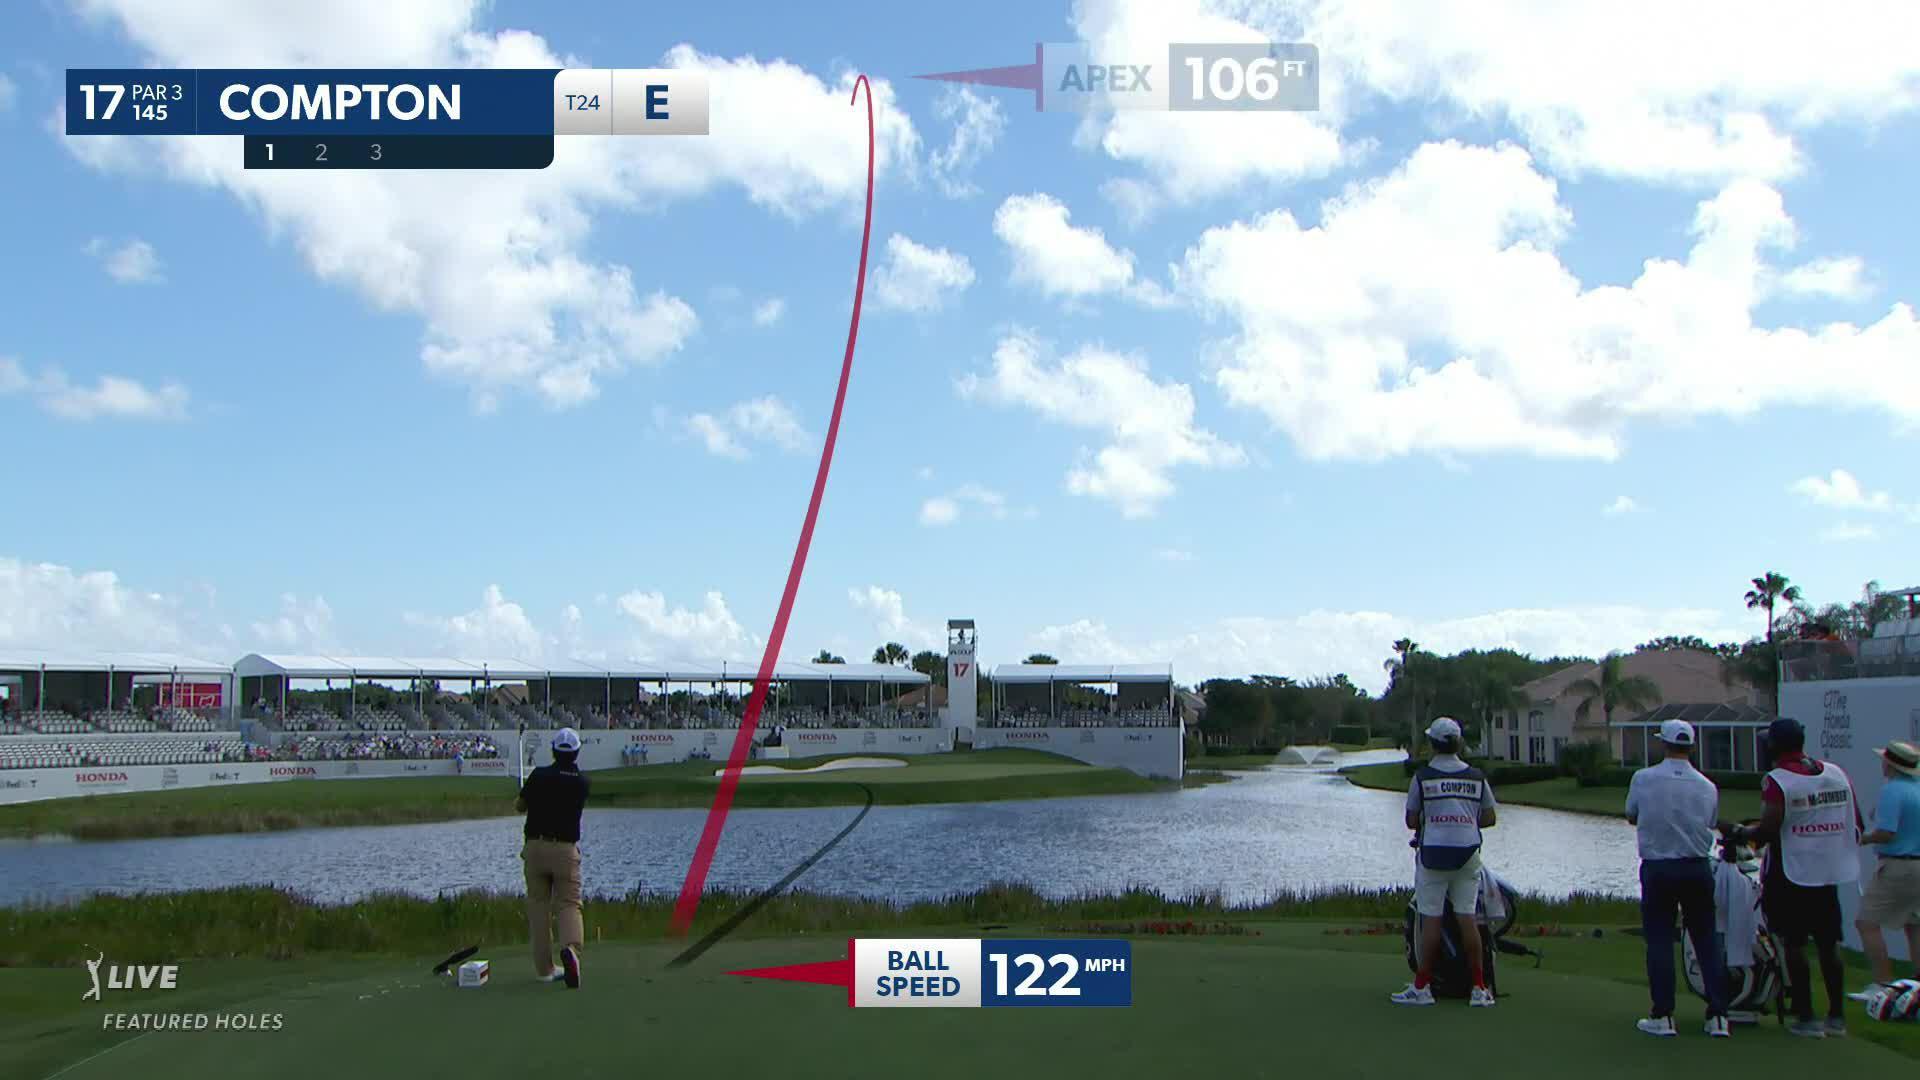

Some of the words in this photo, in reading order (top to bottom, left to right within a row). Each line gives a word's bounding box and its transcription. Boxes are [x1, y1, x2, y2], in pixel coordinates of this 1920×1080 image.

[953, 663, 970, 678] 17
[631, 734, 674, 743] HONDA
[798, 733, 838, 742] HONDA
[1006, 732, 1049, 741] HONDA
[471, 760, 505, 769] HONDA
[270, 766, 317, 776] HONDA
[75, 772, 129, 783] HONDA
[1440, 781, 1477, 795] COMPTON
[1429, 815, 1474, 825] HONDA
